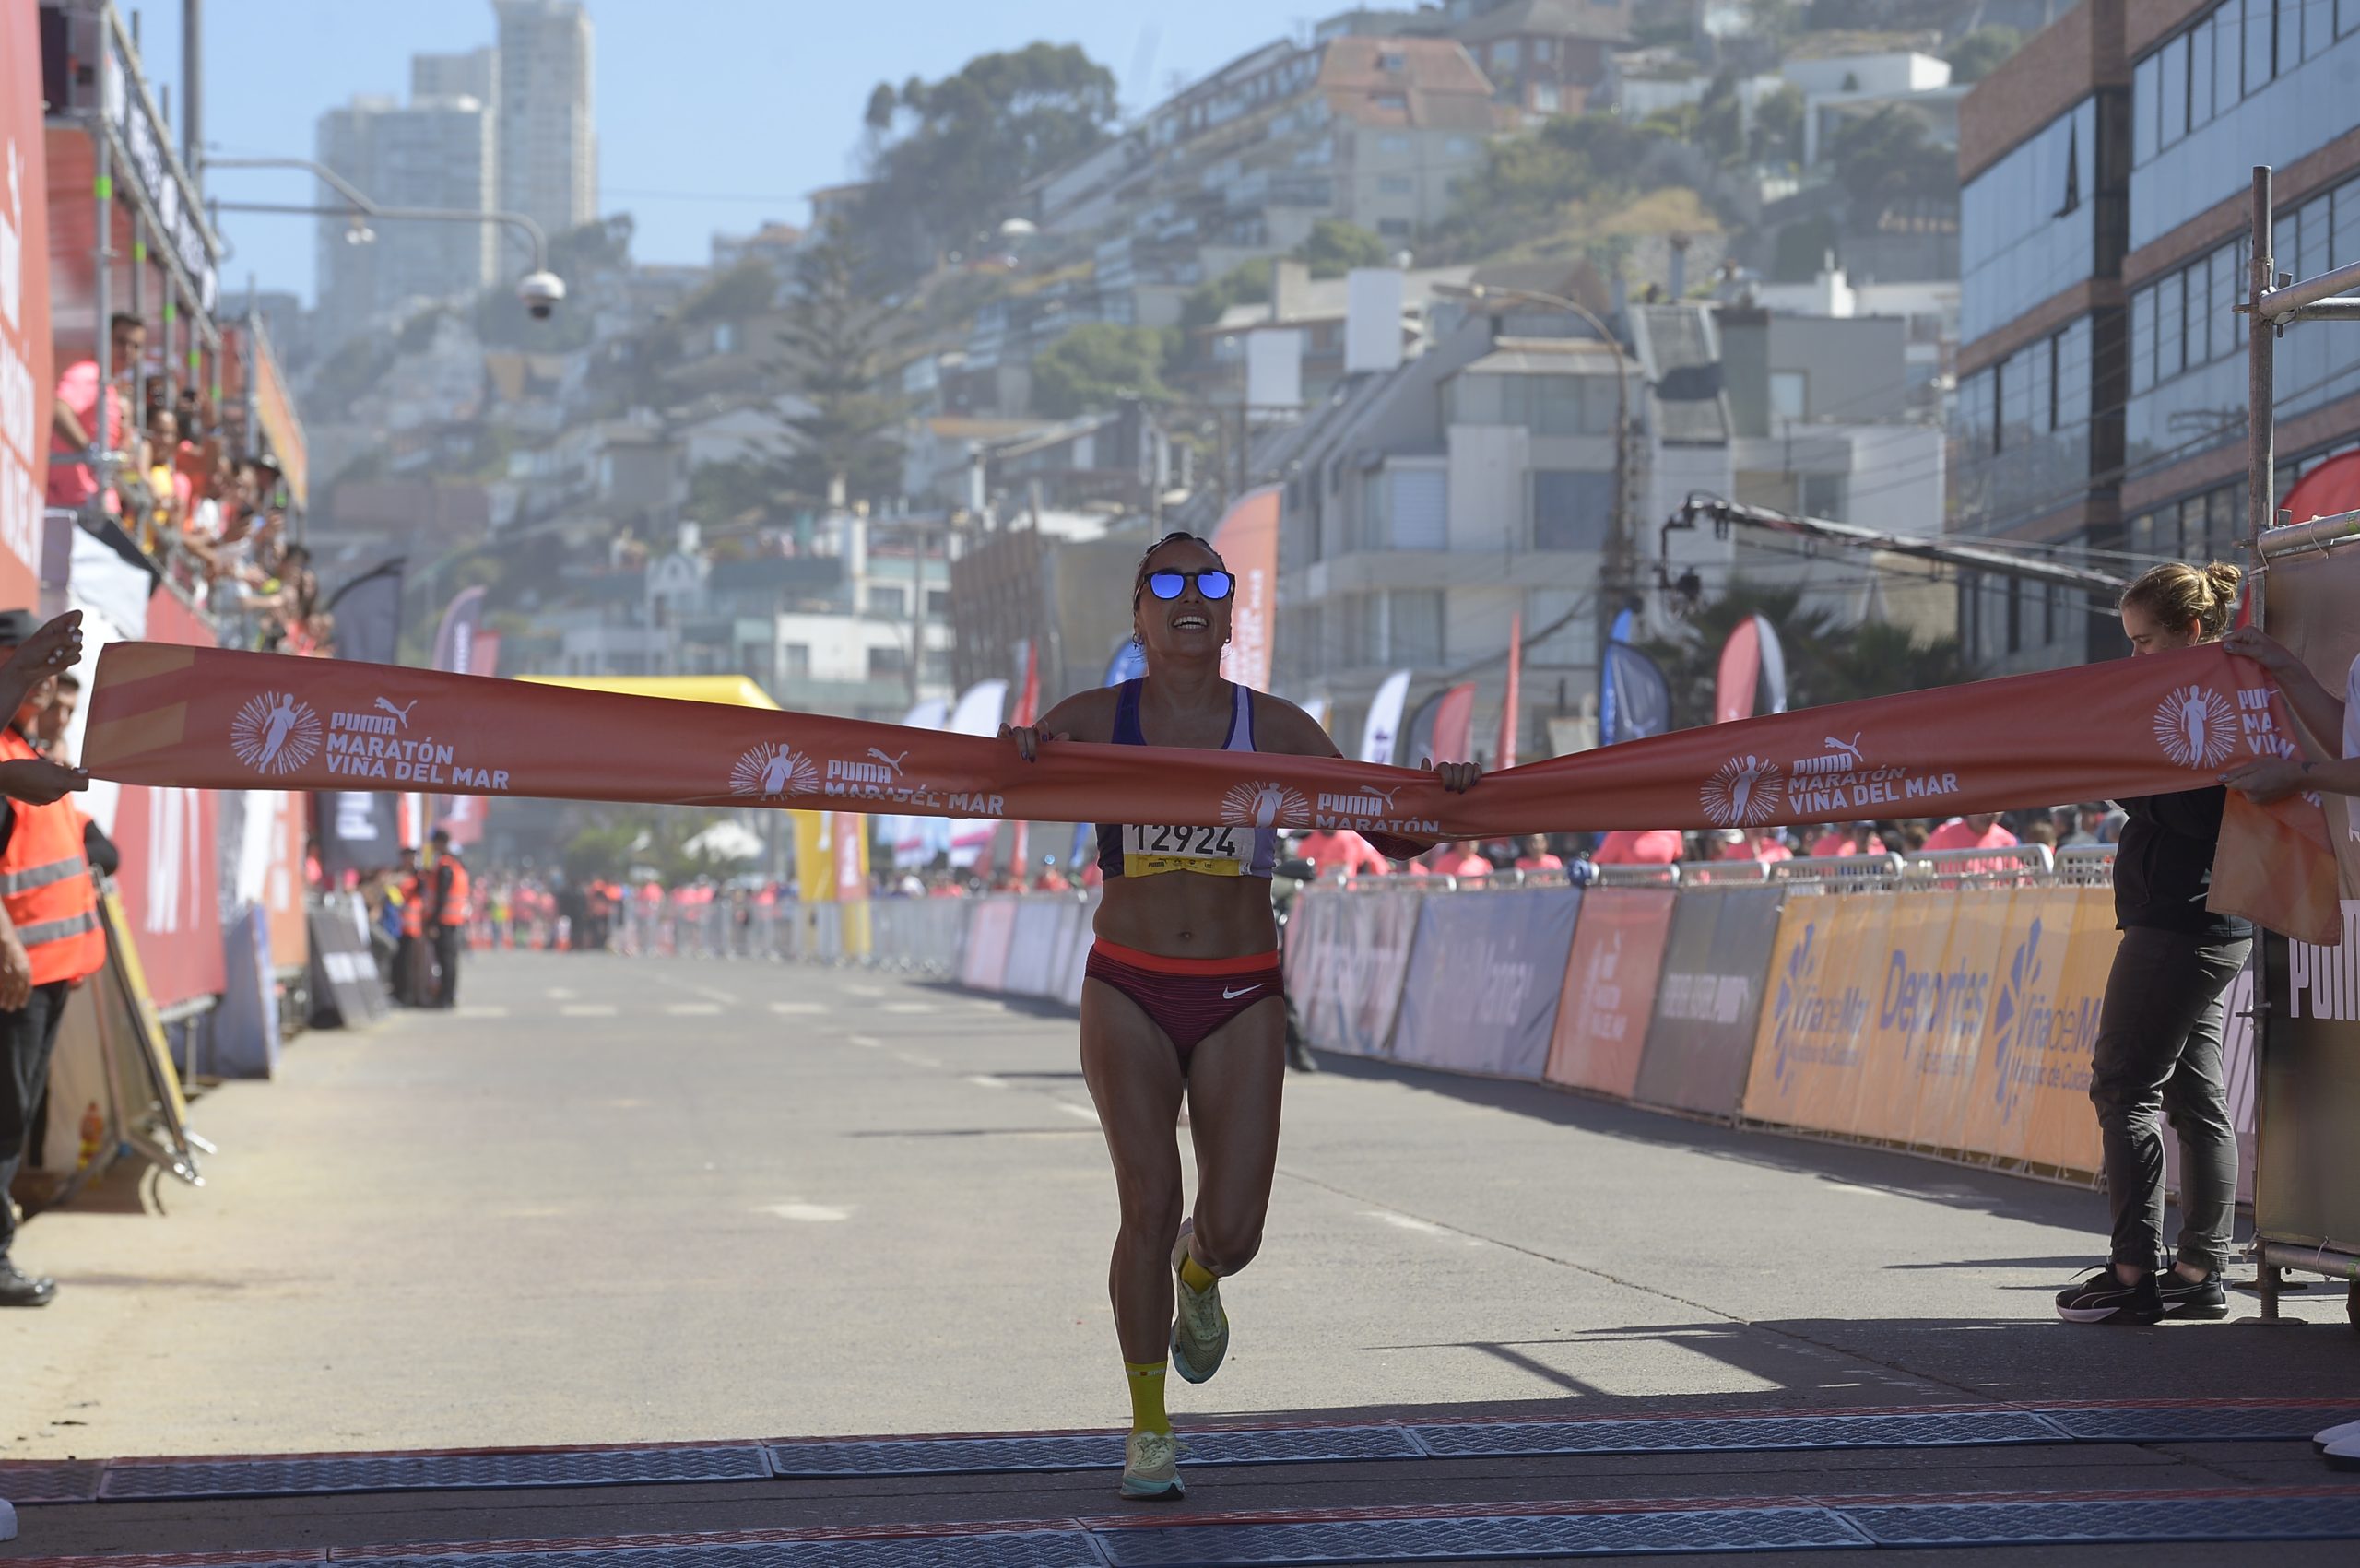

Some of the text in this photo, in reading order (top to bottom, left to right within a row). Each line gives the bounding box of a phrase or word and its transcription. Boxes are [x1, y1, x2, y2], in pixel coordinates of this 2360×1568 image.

[330, 712, 397, 736] PUMA
[325, 733, 454, 765] MARATÓN
[1793, 752, 1853, 776] PUMA
[325, 753, 510, 790] VIÑA DEL MAR
[826, 759, 891, 784] PUMA
[1788, 764, 1907, 795] MARATÓN
[948, 793, 1005, 816] MAR
[1317, 793, 1383, 817] PUMA
[1788, 772, 1960, 816] VIÑA DEL MAR
[1316, 814, 1439, 833] MARATÓN
[1132, 826, 1236, 857] 12924
[2288, 899, 2360, 1021] PUM
[1880, 949, 1989, 1061] Deportes
